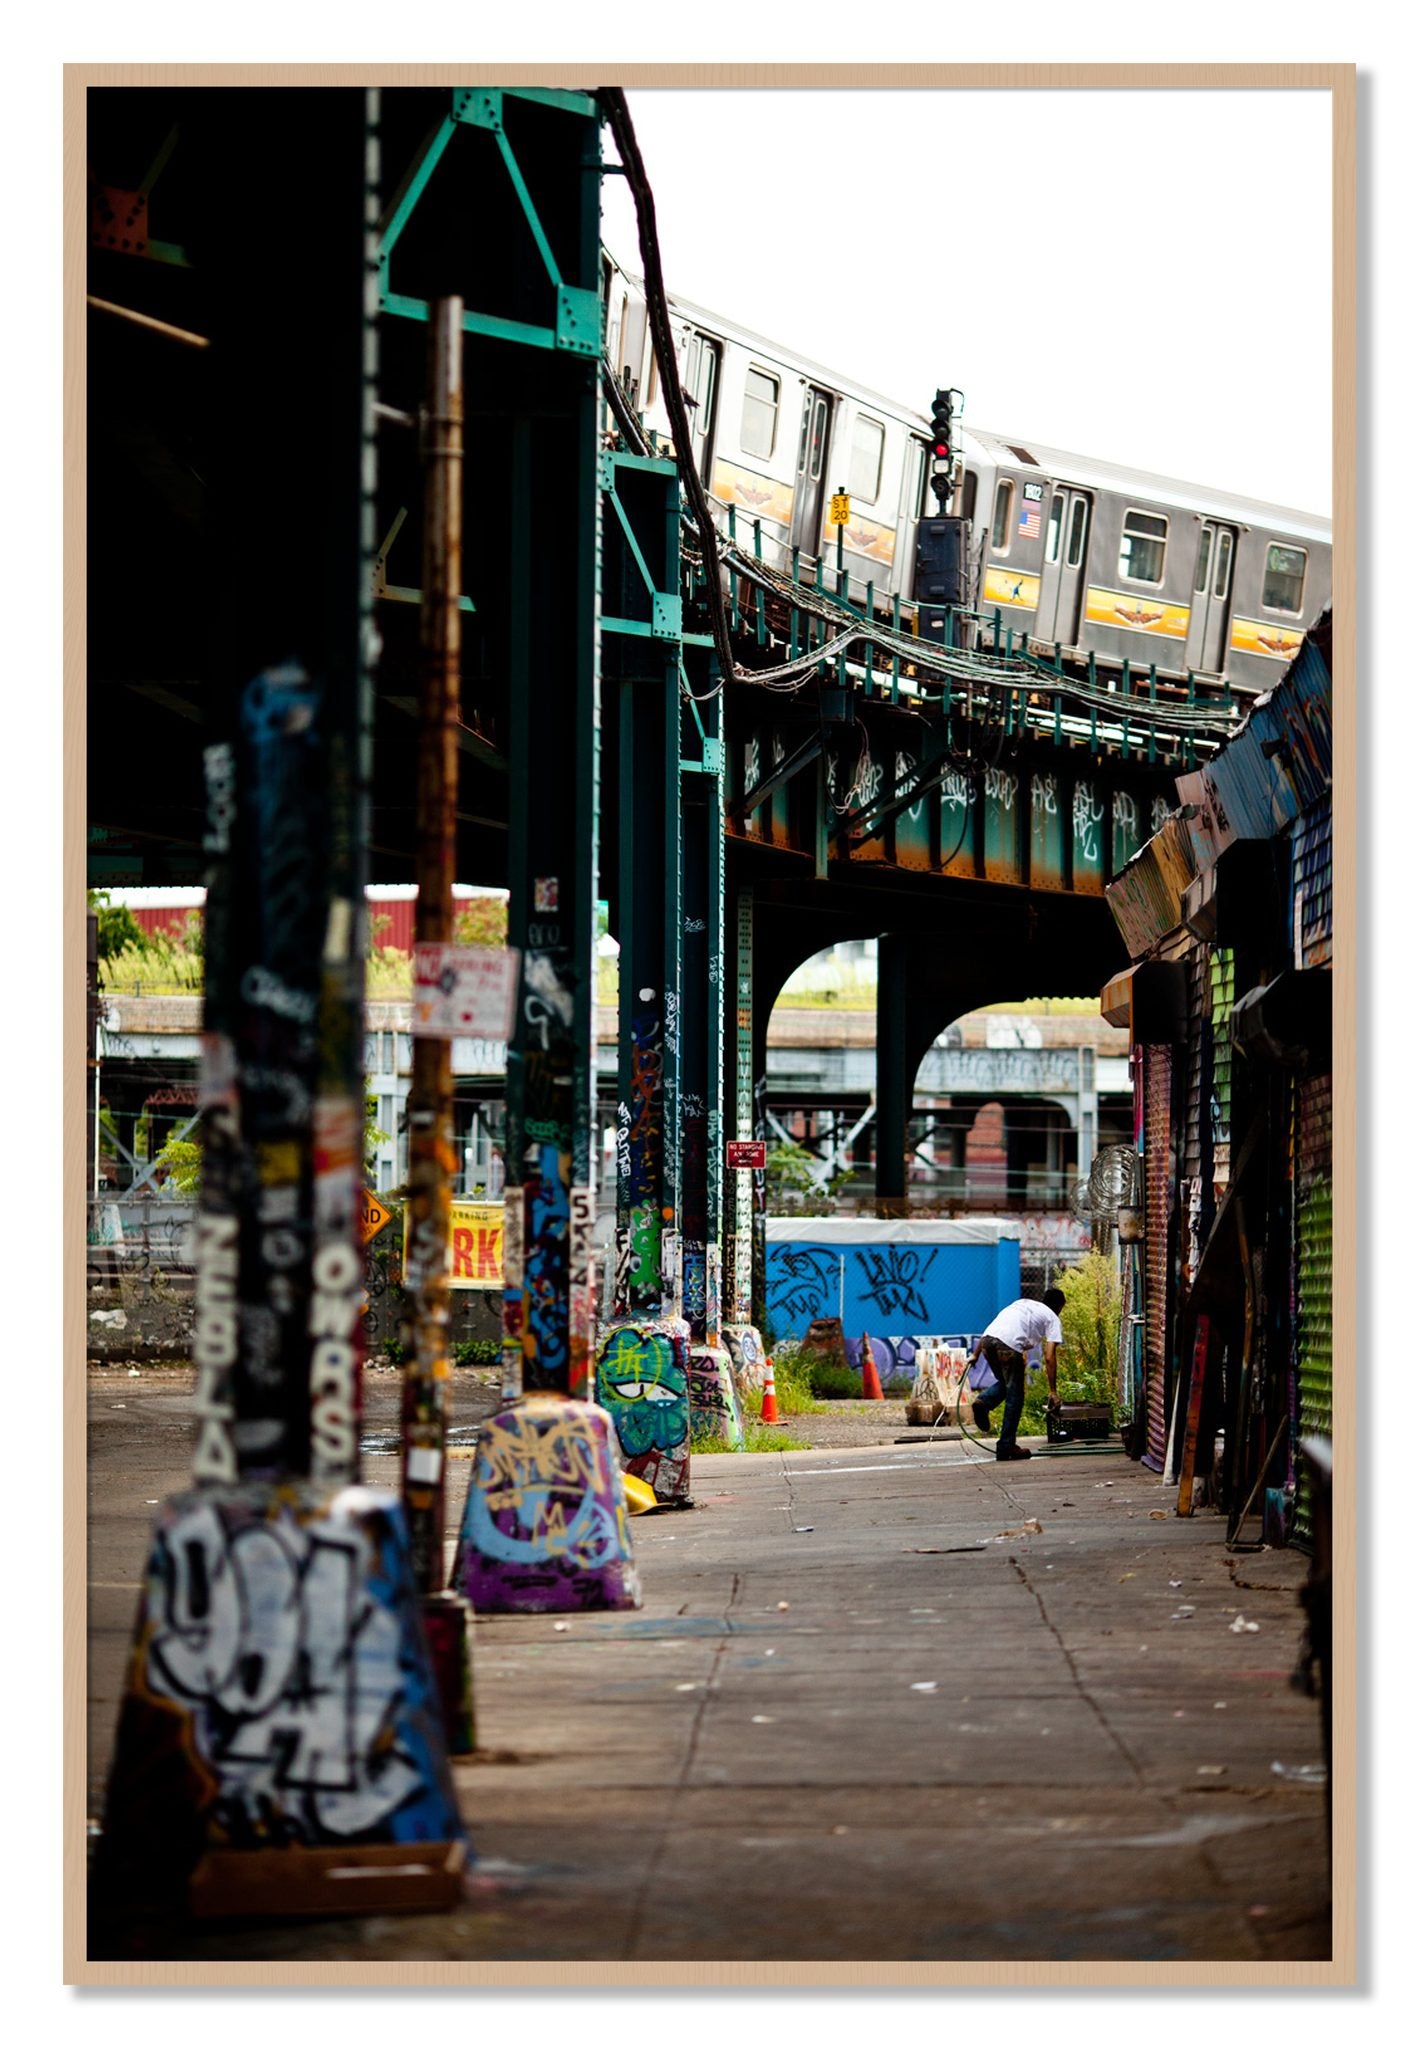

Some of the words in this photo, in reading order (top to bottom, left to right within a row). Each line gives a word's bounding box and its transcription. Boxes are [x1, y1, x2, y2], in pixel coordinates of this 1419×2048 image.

[833, 499, 847, 509] ST
[834, 510, 848, 520] 20
[453, 1228, 501, 1279] RK
